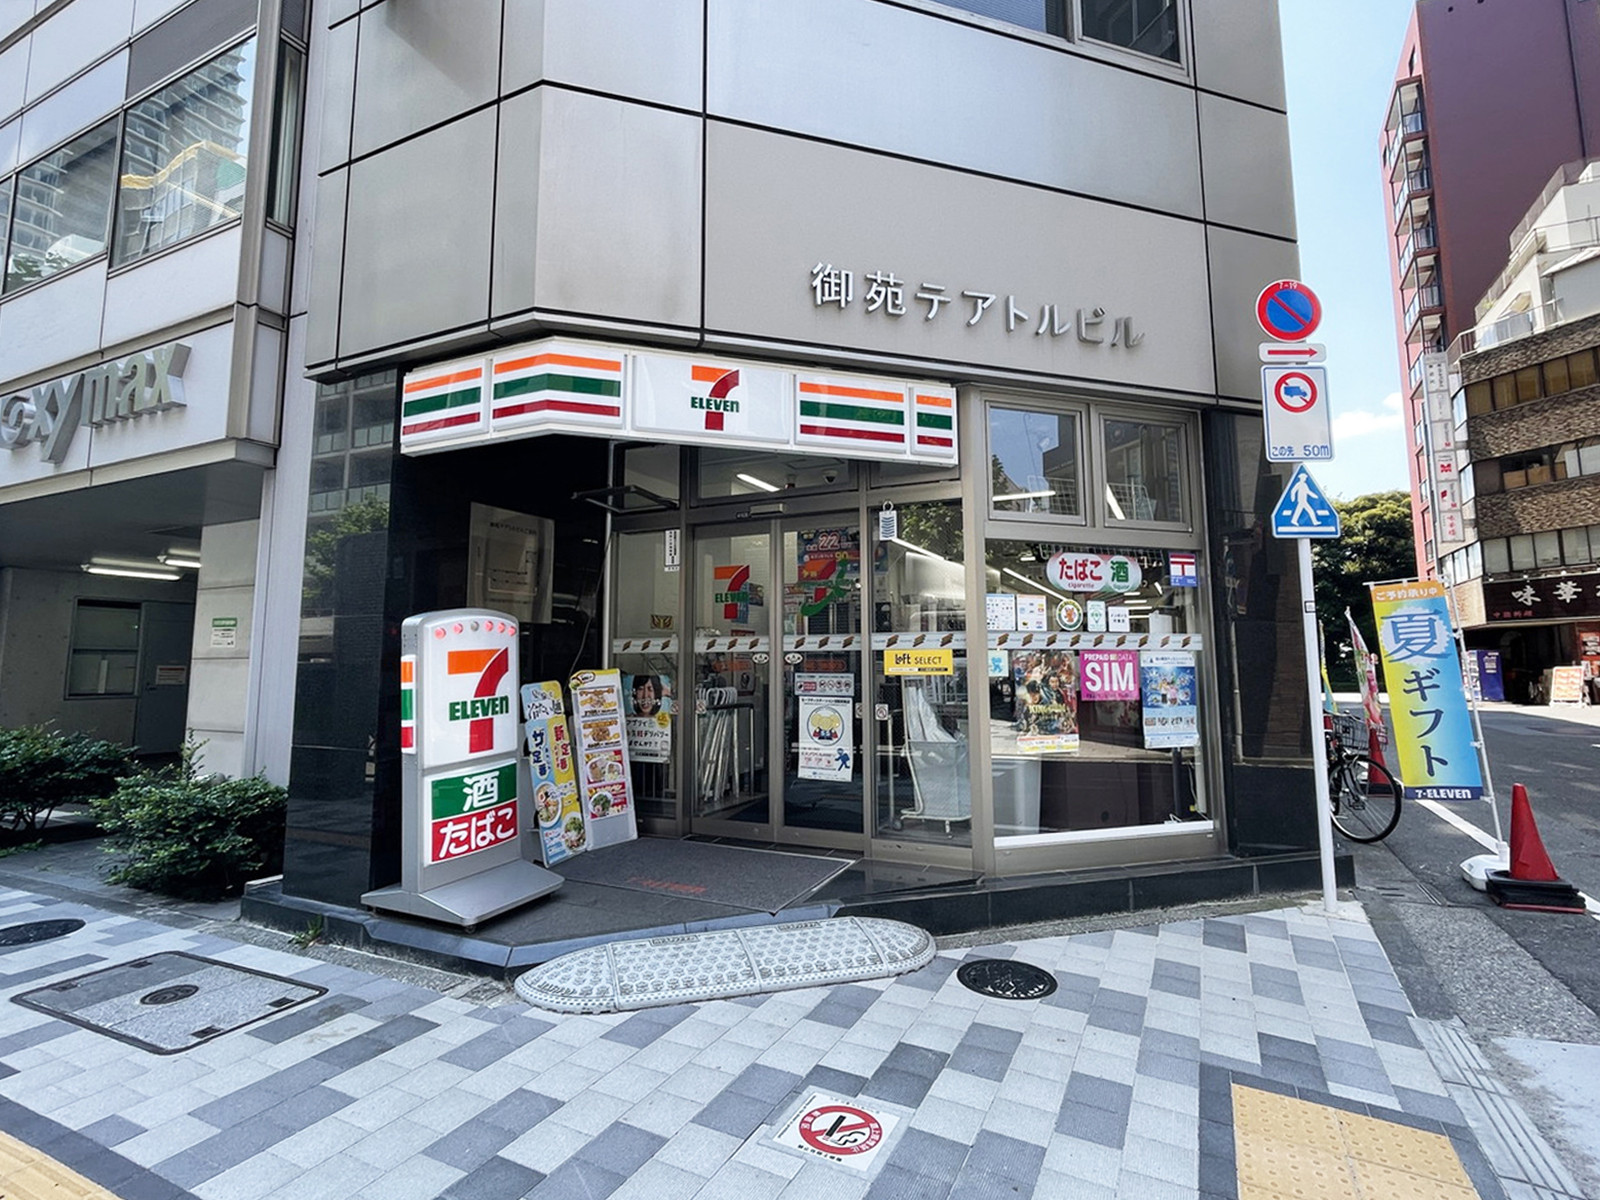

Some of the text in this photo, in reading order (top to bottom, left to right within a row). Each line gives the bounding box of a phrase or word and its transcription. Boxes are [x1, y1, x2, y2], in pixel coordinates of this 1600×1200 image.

[810, 262, 1146, 349] 御苑テアトルビル
[691, 364, 740, 431] 7
[1272, 444, 1330, 457] この先 50m
[1059, 558, 1129, 583] たばこ 酒
[914, 656, 942, 665] SELECT
[1084, 661, 1135, 692] SIM
[447, 646, 509, 754] 7
[1381, 609, 1451, 778] 夏ギフト
[463, 770, 500, 812] 酒
[438, 807, 515, 858] たばこ
